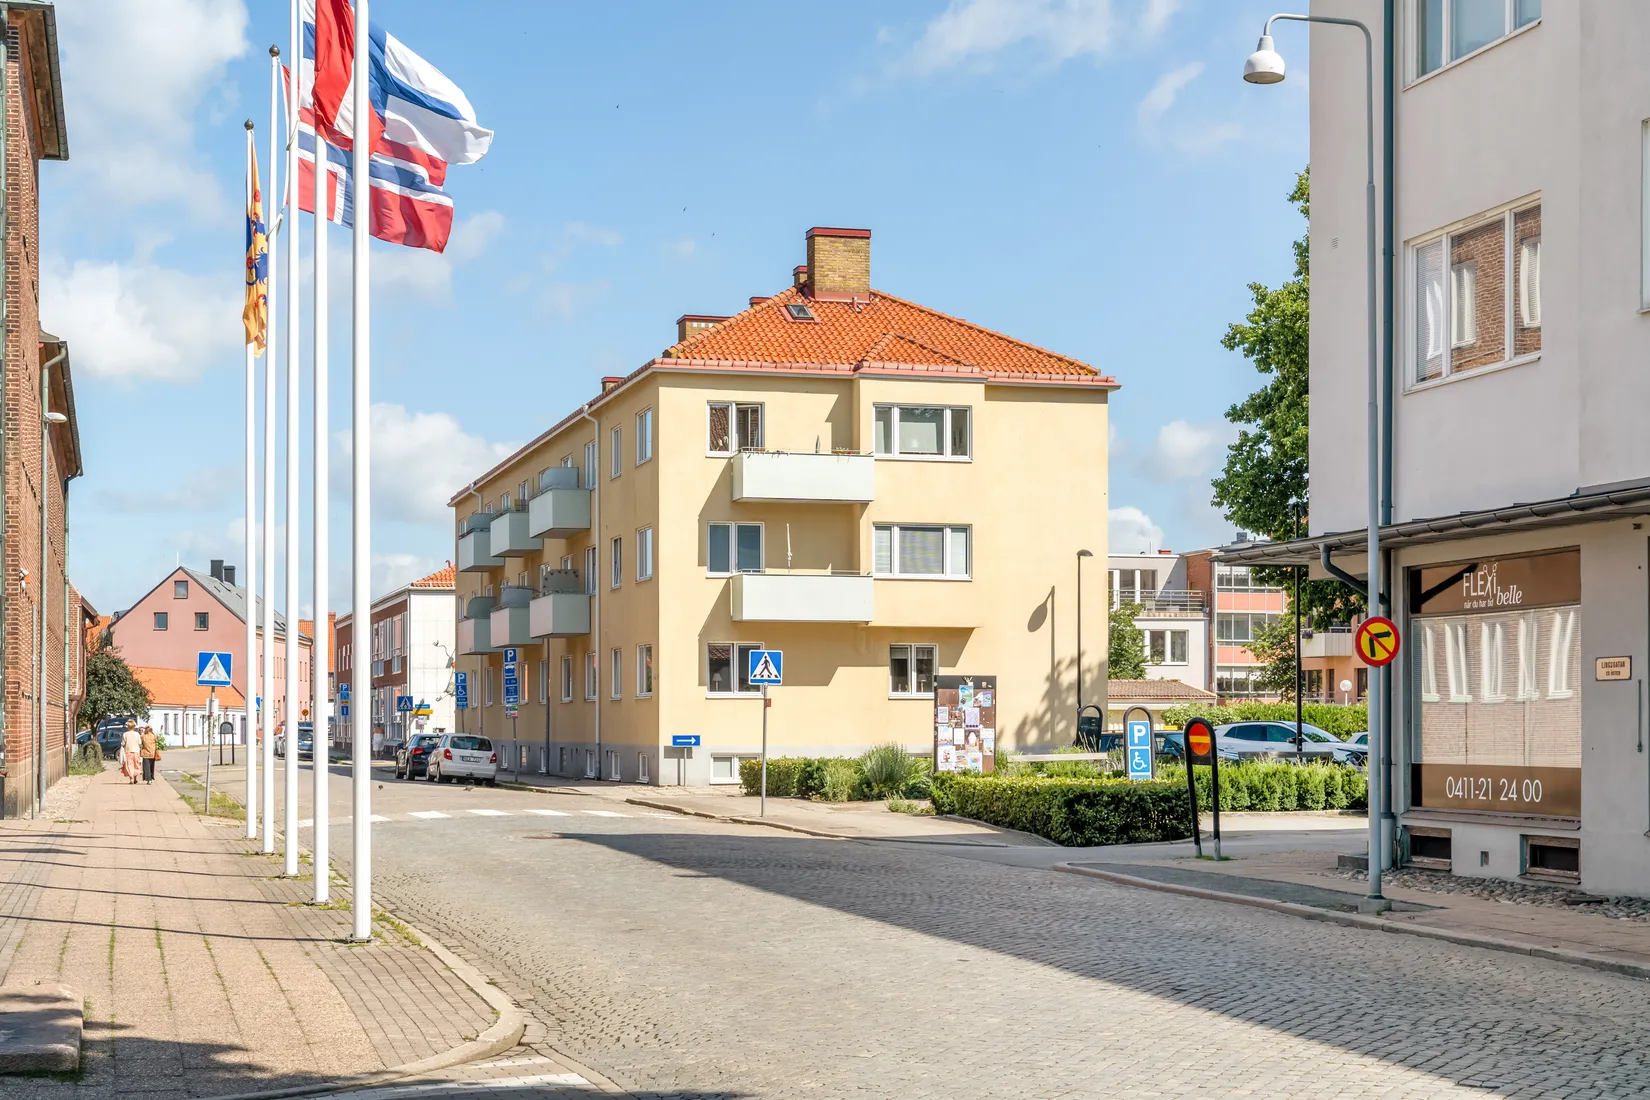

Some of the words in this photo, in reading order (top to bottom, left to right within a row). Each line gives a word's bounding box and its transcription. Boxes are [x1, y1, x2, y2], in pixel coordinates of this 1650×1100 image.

[1497, 585, 1523, 605] belle
[1472, 600, 1478, 608] du
[1479, 599, 1487, 607] har
[507, 650, 514, 662] P
[457, 673, 465, 684] P
[1133, 725, 1147, 744] P
[1446, 776, 1492, 800] 0411-21
[1500, 778, 1517, 801] 24
[1522, 779, 1543, 802] 00
